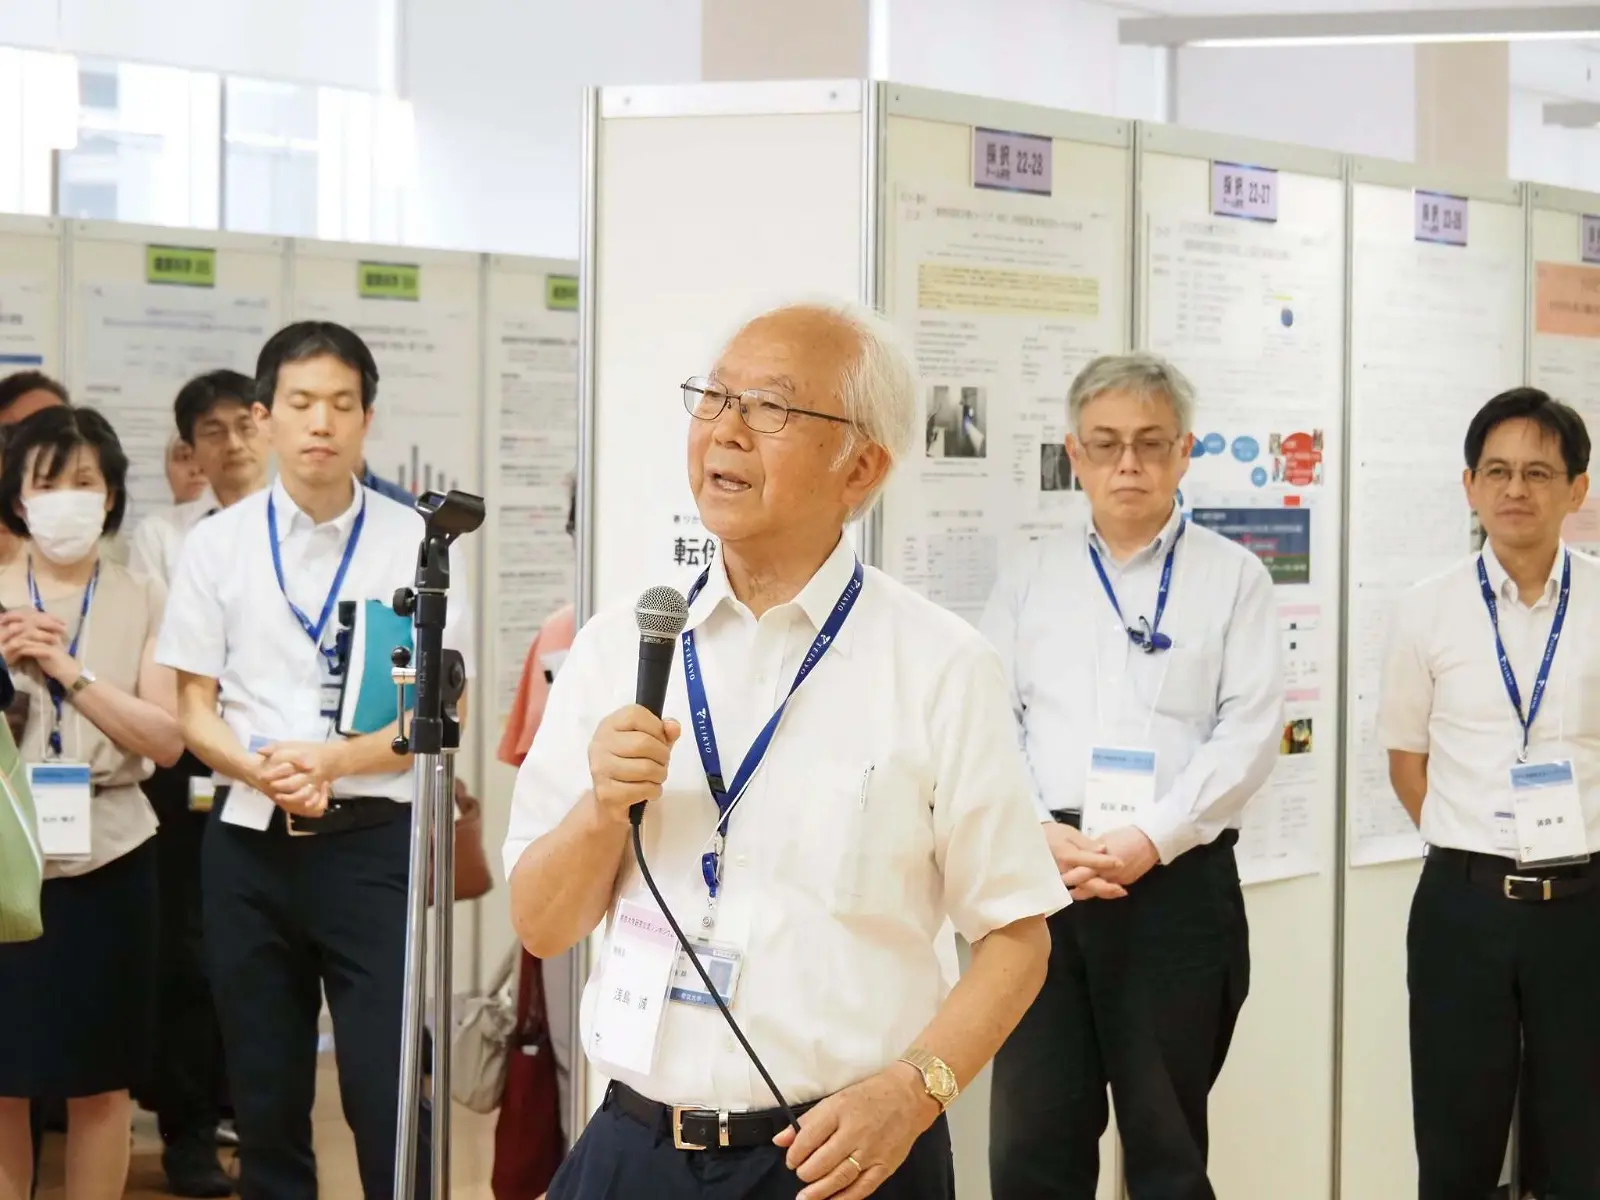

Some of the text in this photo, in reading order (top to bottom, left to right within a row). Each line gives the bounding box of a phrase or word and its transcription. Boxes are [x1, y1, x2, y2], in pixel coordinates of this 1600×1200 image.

[685, 648, 696, 681] TEIKYO
[800, 643, 822, 675] TEIKYO
[698, 719, 712, 753] TEIKYO
